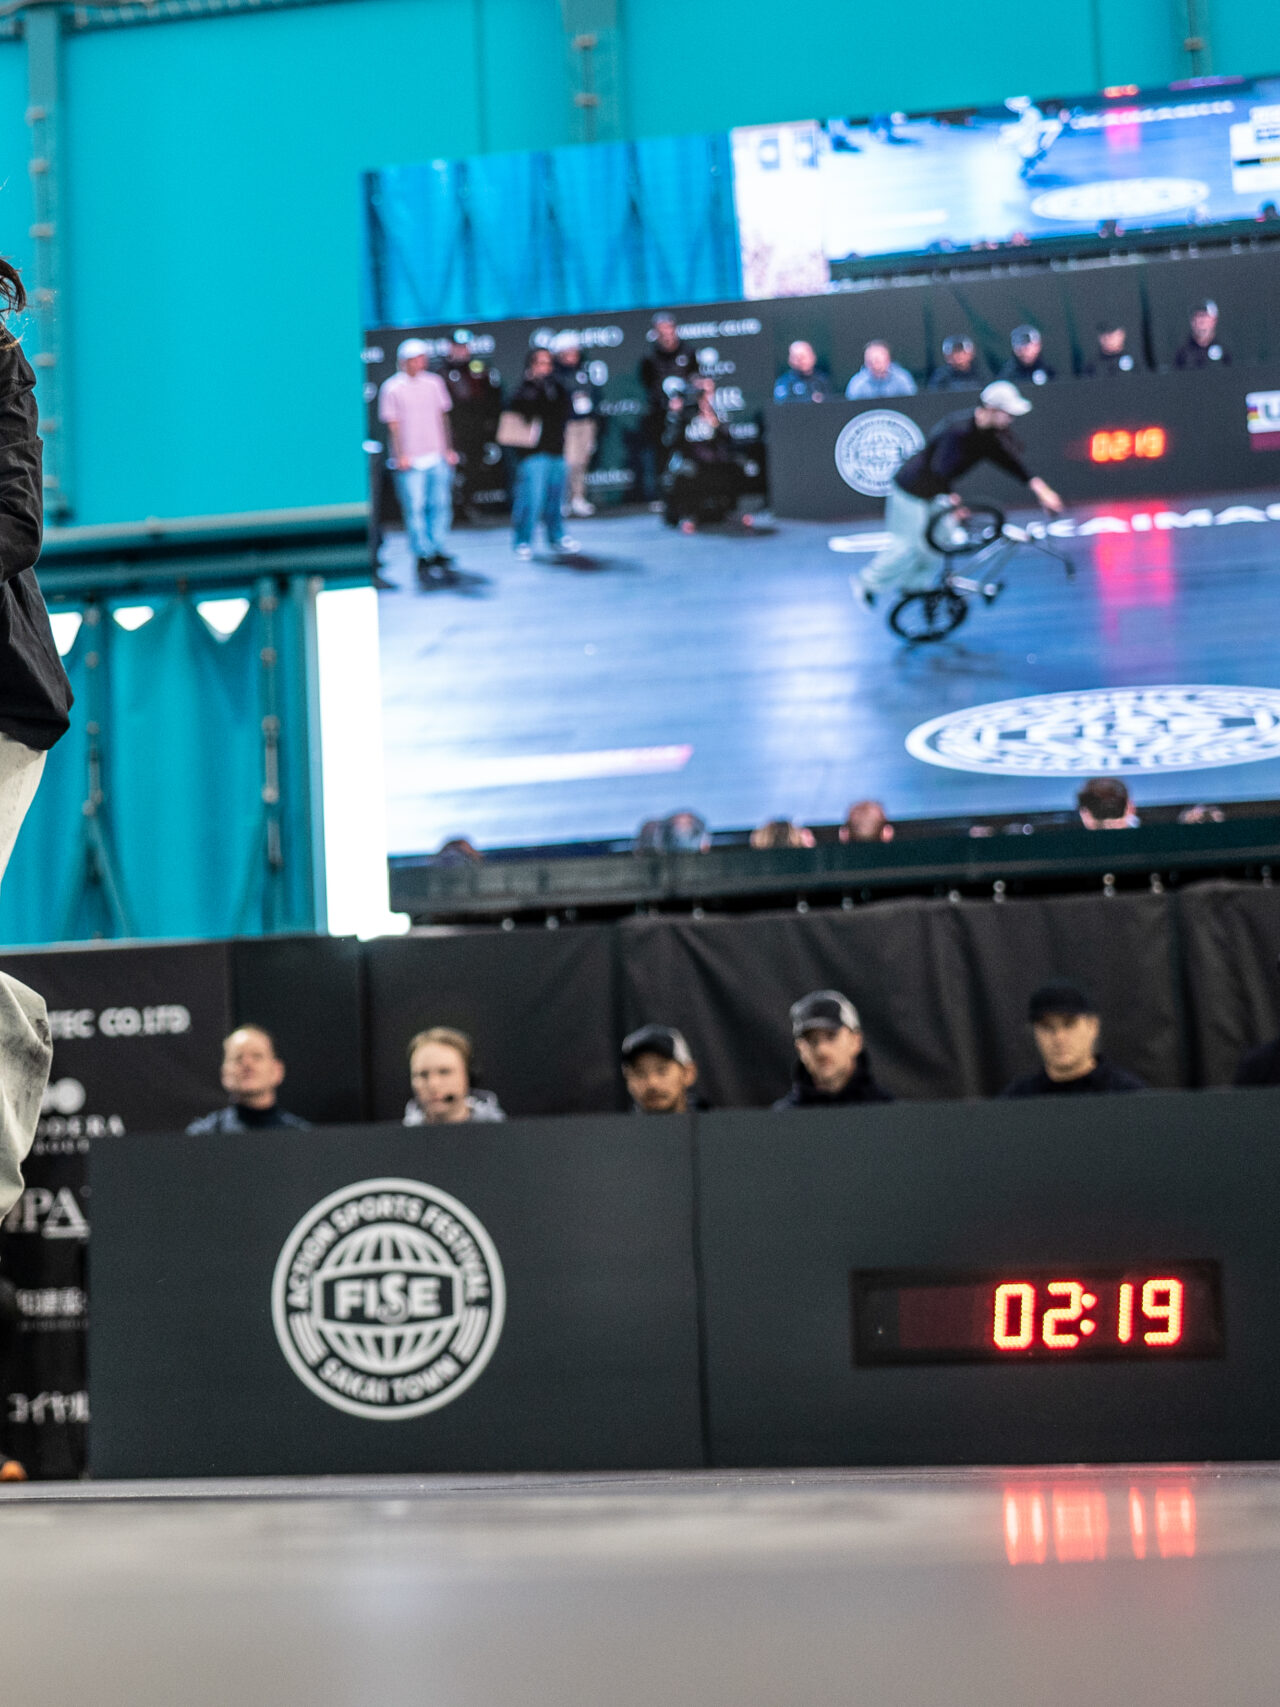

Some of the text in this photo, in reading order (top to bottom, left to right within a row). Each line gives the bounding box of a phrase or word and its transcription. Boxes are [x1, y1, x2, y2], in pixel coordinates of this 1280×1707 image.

[287, 1194, 490, 1309] ACTION SPORTS FESTIVAL
[334, 1272, 441, 1324] FISE
[993, 1278, 1184, 1349] 02:19
[319, 1353, 462, 1402] SAKAI TOWN
